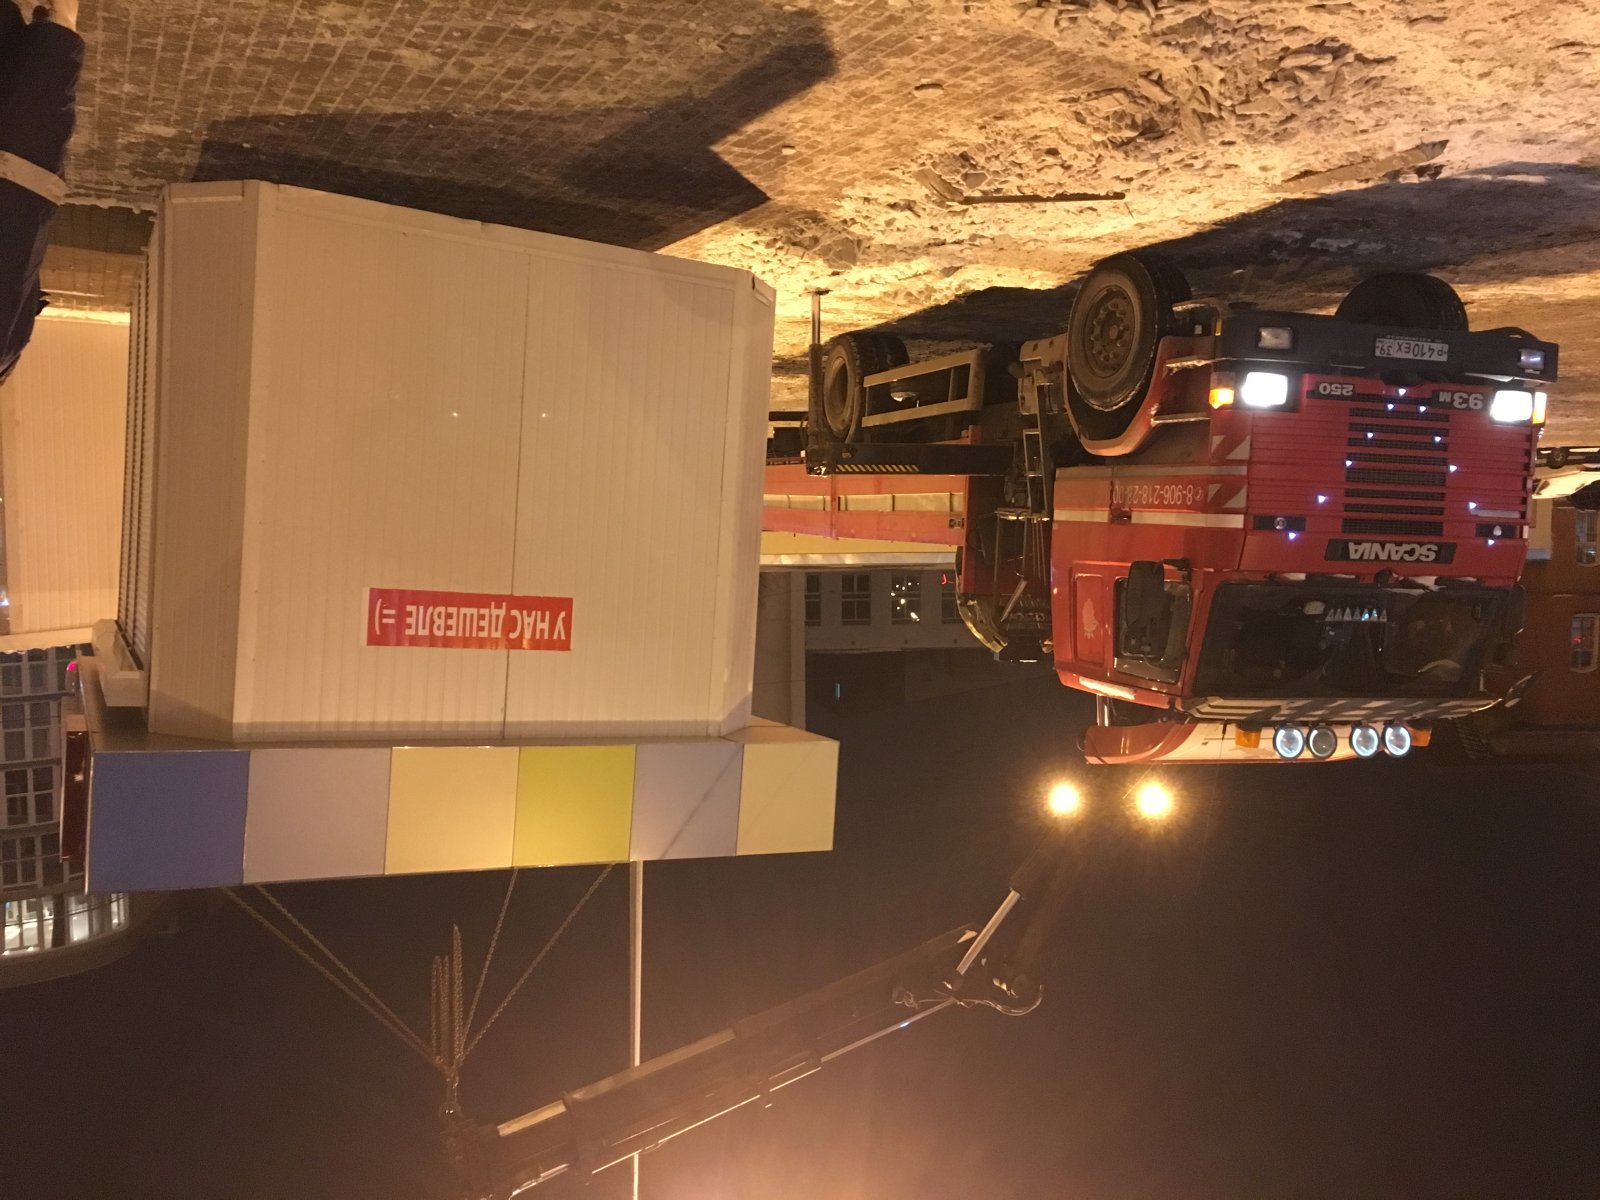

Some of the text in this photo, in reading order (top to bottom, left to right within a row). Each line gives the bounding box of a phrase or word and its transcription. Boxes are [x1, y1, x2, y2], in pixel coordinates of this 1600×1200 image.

[1319, 383, 1354, 396] 250
[1348, 542, 1438, 562] SCANIA
[404, 602, 506, 638] ДЕШЕВЛЕ
[509, 609, 550, 640] НАС
[553, 611, 566, 640] У
